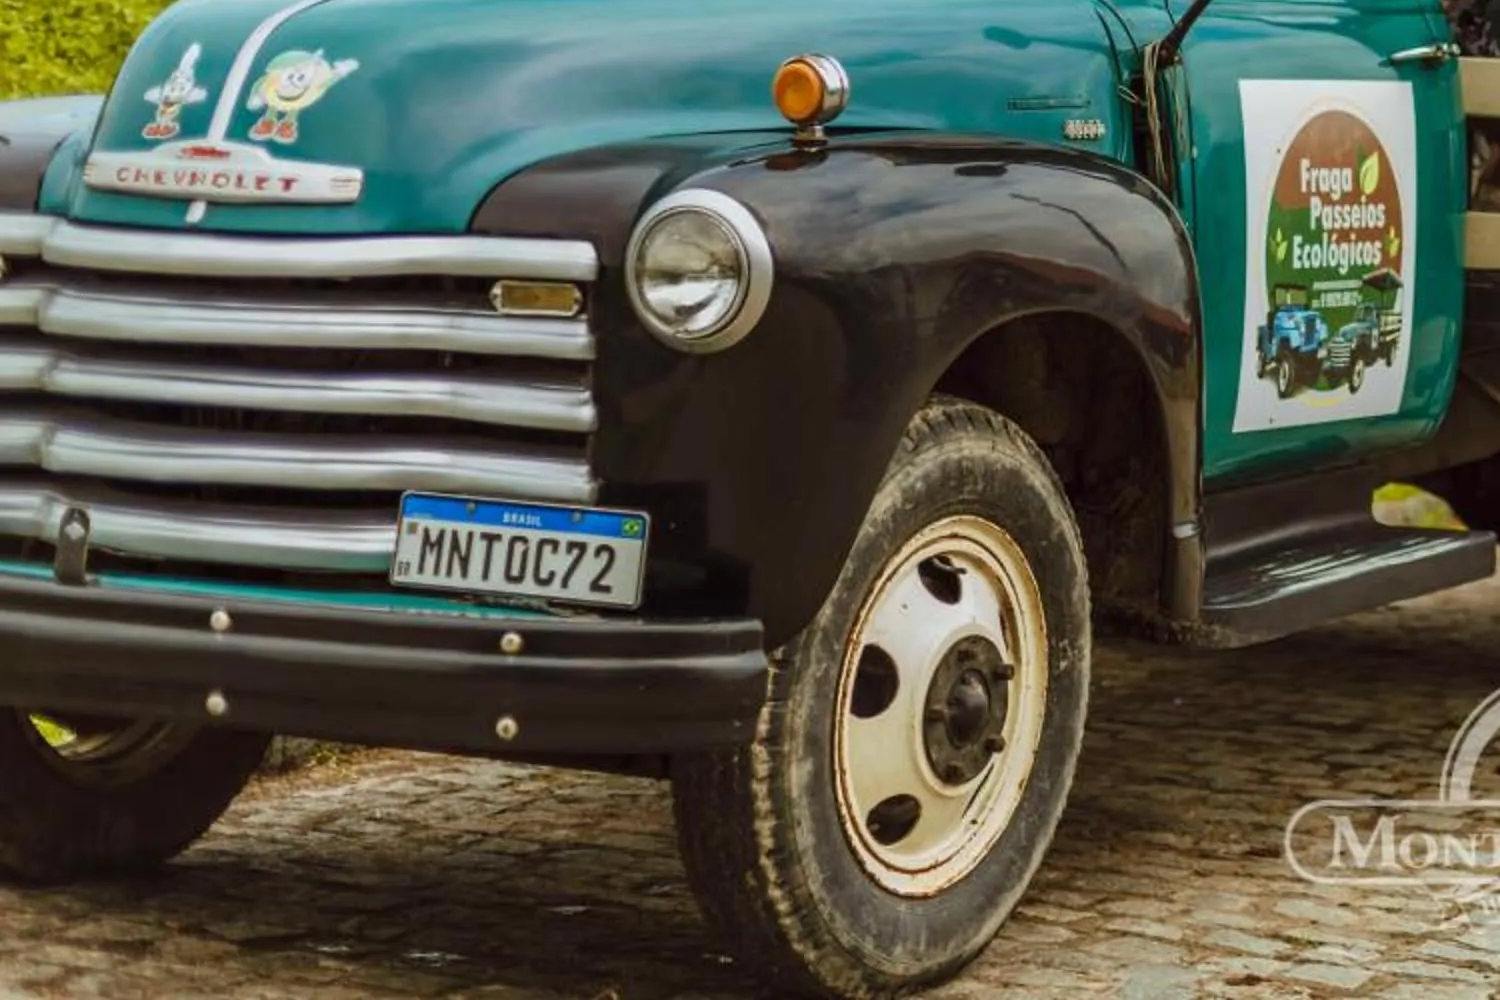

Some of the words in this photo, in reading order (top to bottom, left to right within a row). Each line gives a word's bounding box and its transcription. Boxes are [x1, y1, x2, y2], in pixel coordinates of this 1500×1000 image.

[115, 166, 299, 192] CHEVROLET
[1300, 157, 1353, 199] Fraga
[1309, 195, 1386, 231] Passeios
[1292, 231, 1382, 275] Ecológicos
[502, 511, 543, 528] BRASIL
